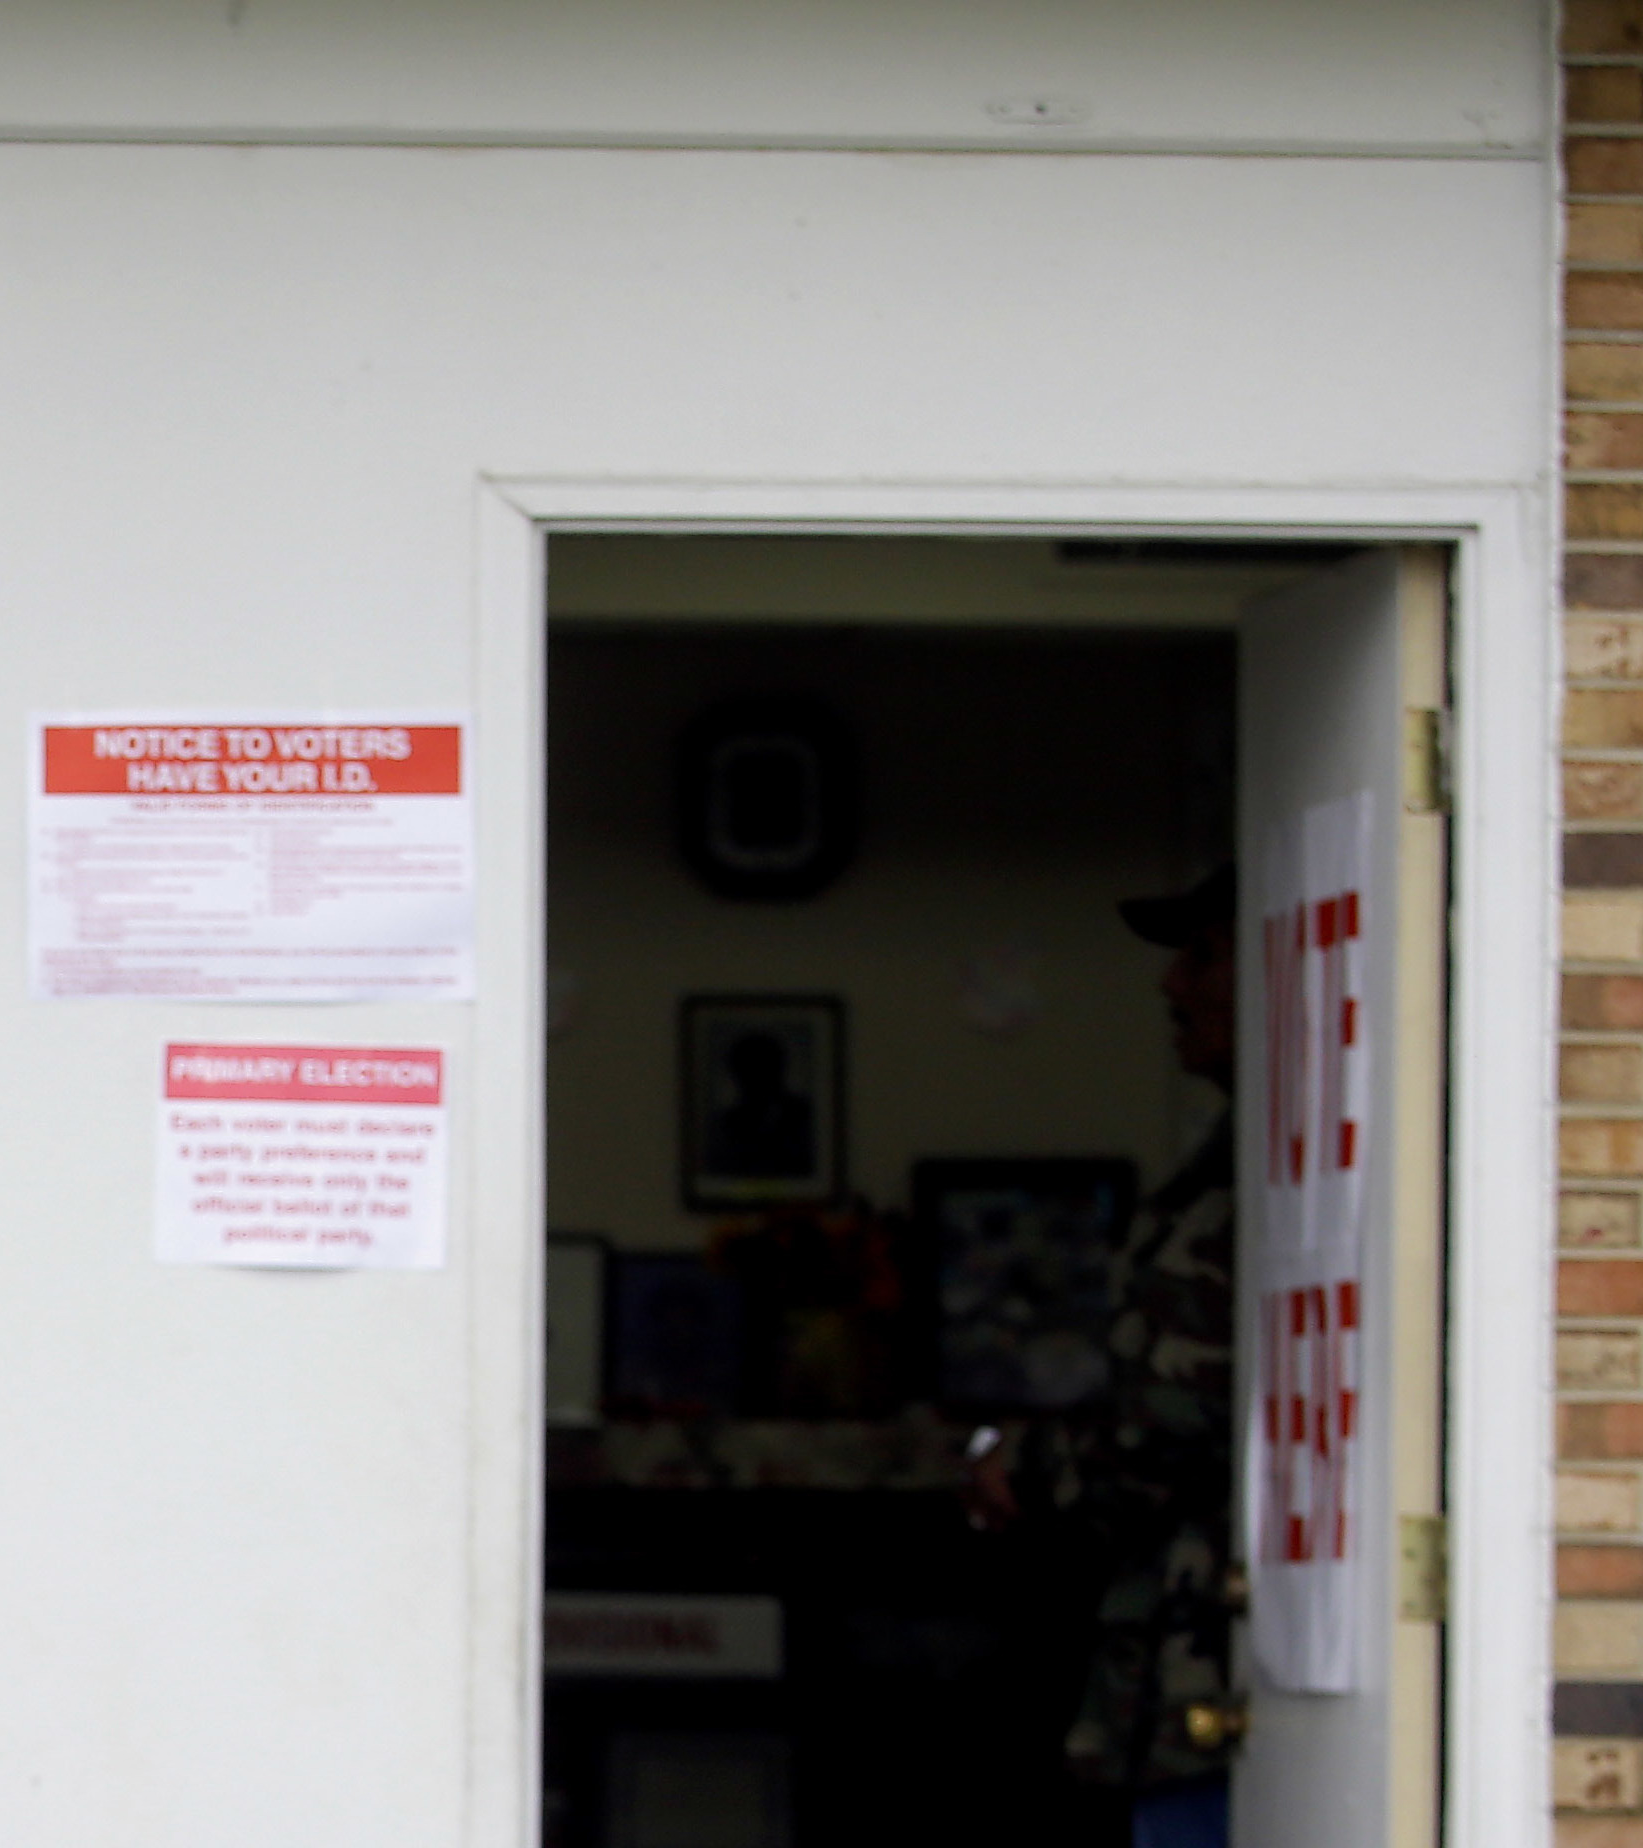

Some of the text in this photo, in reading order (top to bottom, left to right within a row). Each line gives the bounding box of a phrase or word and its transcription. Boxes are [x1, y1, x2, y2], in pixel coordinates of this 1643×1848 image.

[93, 729, 412, 760] NOTICE TO VOTERS
[127, 762, 378, 793] HAVE YOUR I.D.
[1261, 891, 1361, 1188] VOTE
[171, 1056, 437, 1088] PRIMARY ELECTION
[170, 1114, 434, 1135] Each voter must declare
[199, 1143, 252, 1163] party
[261, 1144, 376, 1163] preference
[384, 1146, 425, 1163] and
[237, 1173, 314, 1187] receive
[323, 1173, 368, 1192] only
[376, 1175, 409, 1190] the
[192, 1196, 264, 1213] official
[272, 1198, 331, 1215] ballot
[369, 1200, 409, 1217] that
[223, 1226, 309, 1245] political
[1258, 1280, 1360, 1566] HERE
